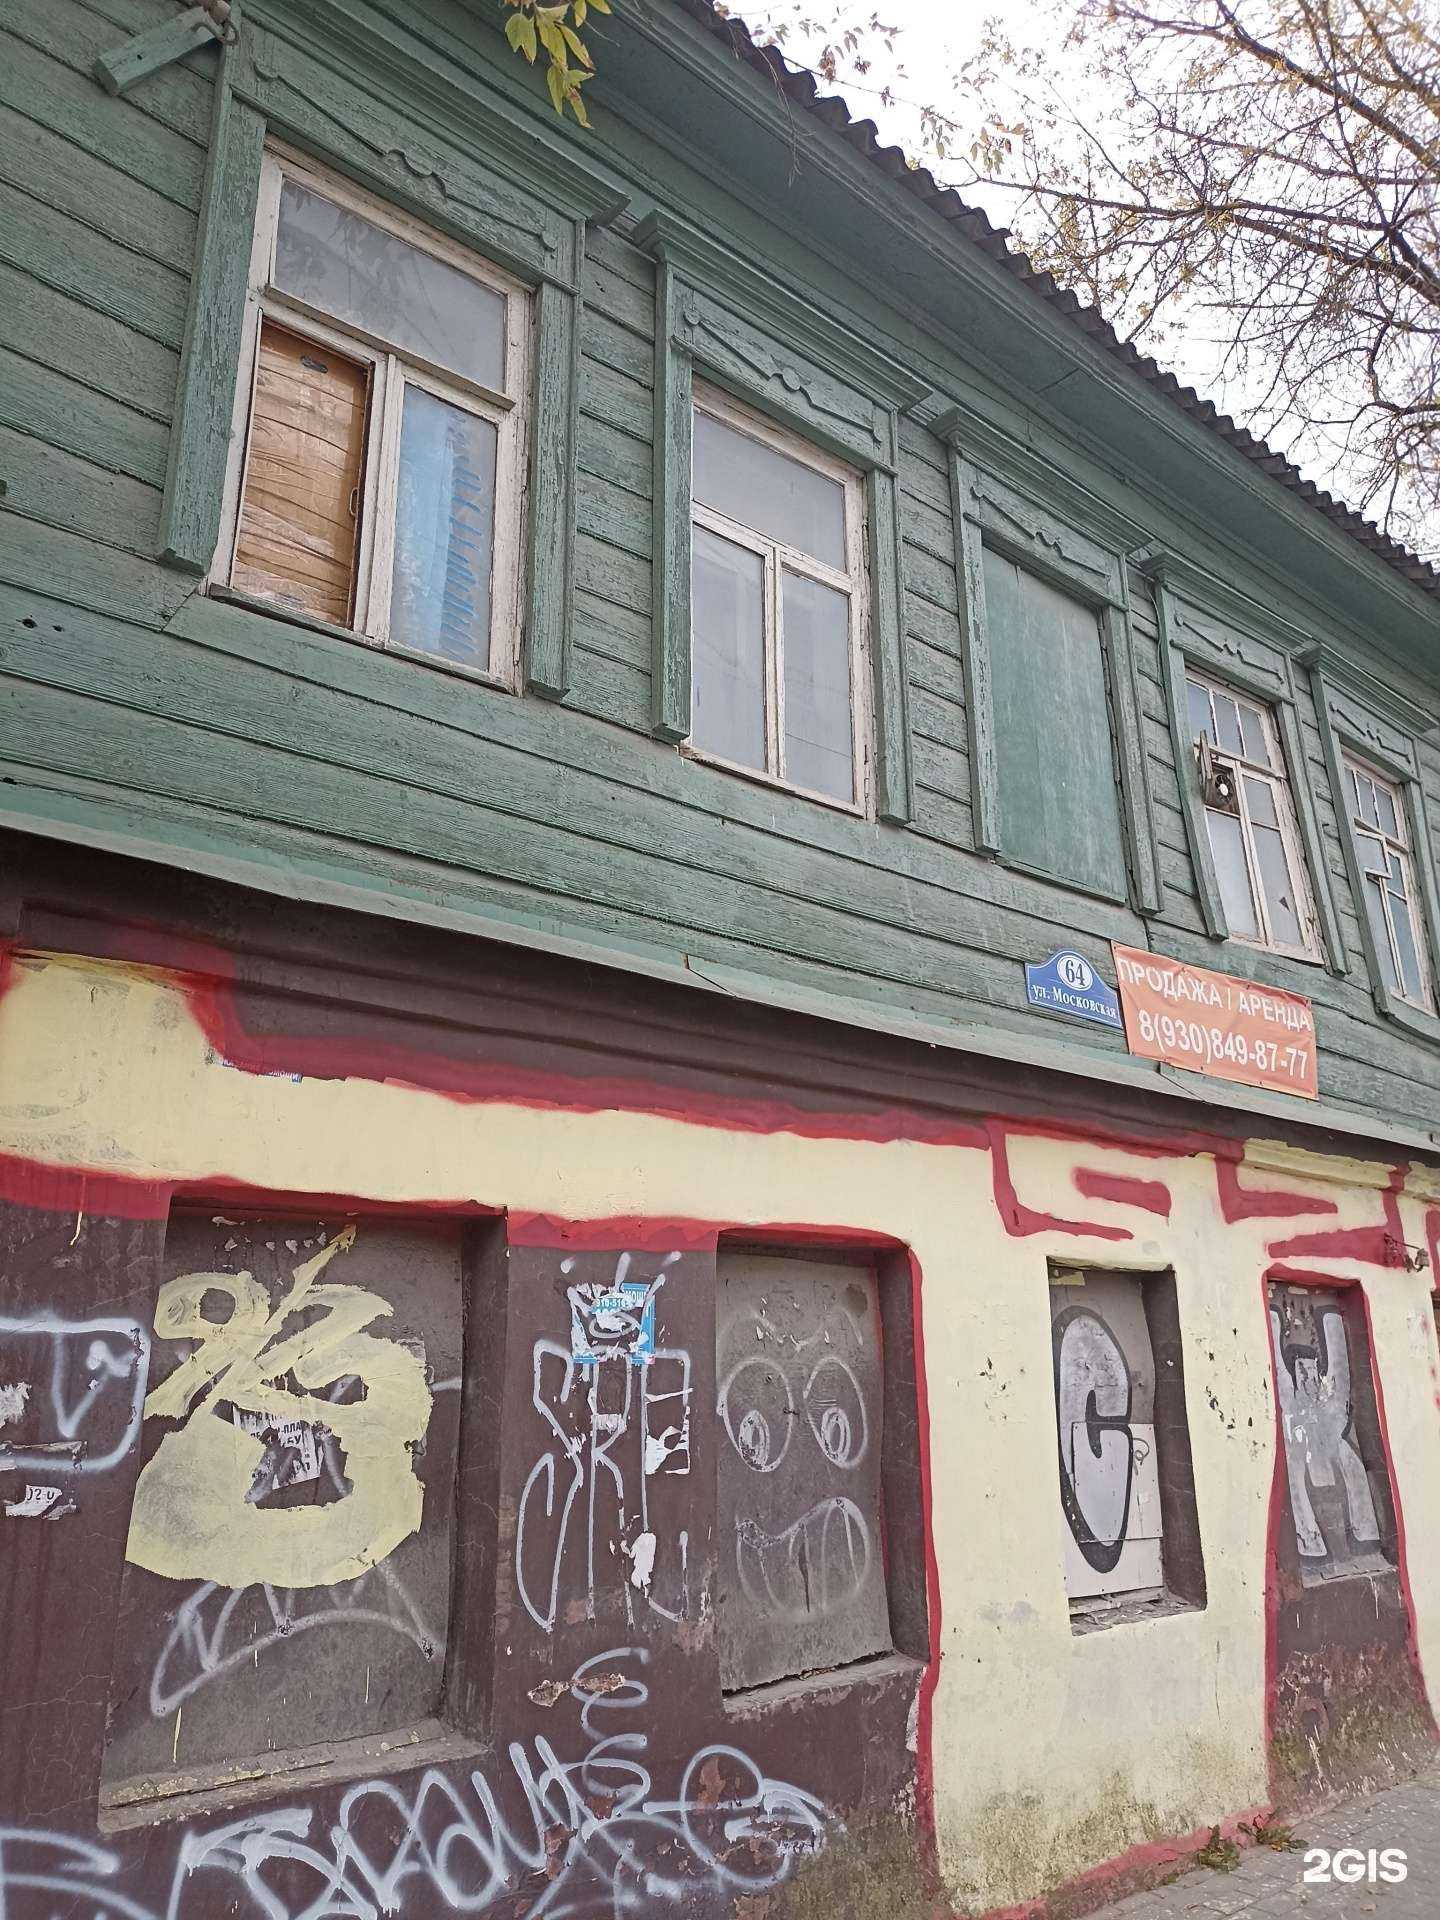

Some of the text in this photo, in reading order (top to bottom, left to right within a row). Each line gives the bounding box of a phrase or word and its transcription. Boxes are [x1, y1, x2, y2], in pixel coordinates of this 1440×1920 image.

[1031, 985, 1051, 1000] ул.
[1065, 959, 1086, 987] 64
[1117, 958, 1223, 1009] ПРОДАЖА
[1238, 991, 1312, 1032] АРЕНДА
[1138, 1009, 1308, 1079] 8(930)849-87-77
